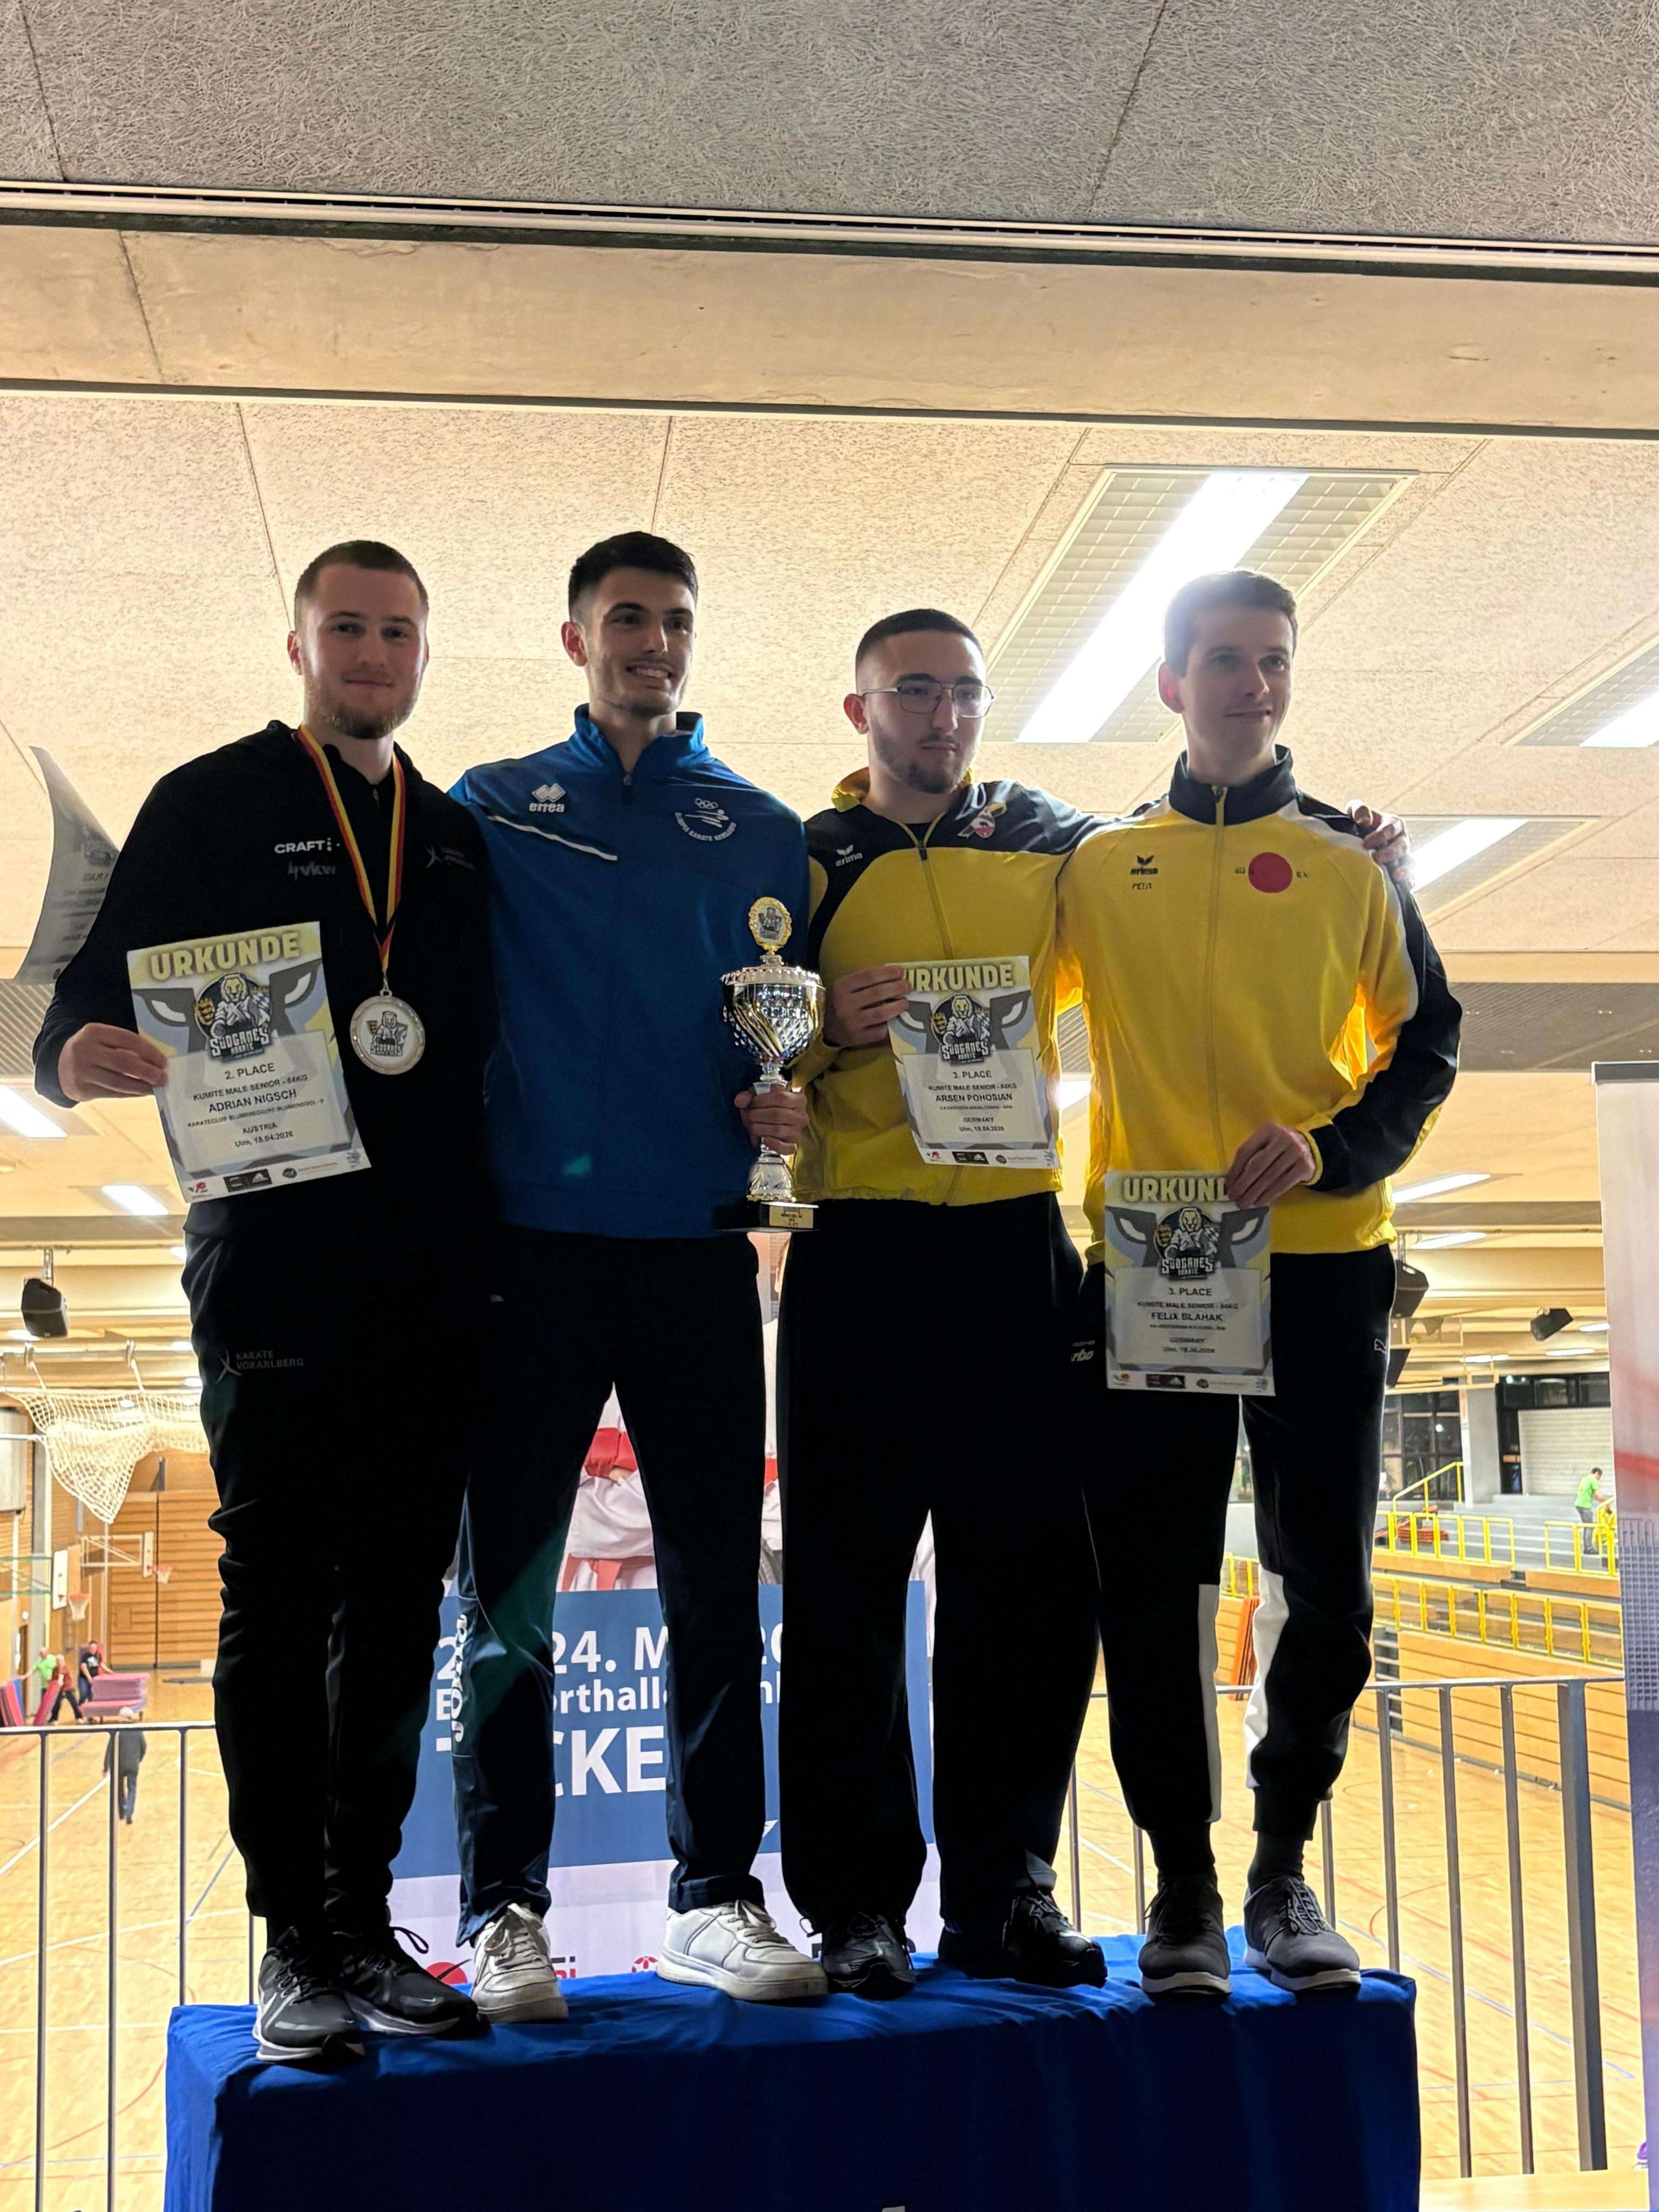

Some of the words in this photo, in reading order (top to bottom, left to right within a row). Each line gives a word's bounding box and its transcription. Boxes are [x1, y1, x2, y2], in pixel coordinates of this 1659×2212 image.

[274, 840, 326, 854] CRAFT
[835, 852, 864, 867] erima
[1130, 866, 1158, 875] erima
[151, 931, 300, 981] URKUNDE
[225, 1071, 234, 1080] 2.
[237, 1062, 275, 1077] PLACE
[962, 1070, 992, 1078] PLACE
[193, 1089, 225, 1101] KUMITE
[226, 1085, 249, 1095] MALE
[250, 1079, 280, 1091] SENIOR
[209, 1097, 252, 1112] ADRIAN
[254, 1089, 297, 1104] NIGSCH
[242, 1122, 278, 1135] AUSTRIA
[1179, 1287, 1212, 1296] PLACE
[1182, 1313, 1223, 1321] BLAHAK
[235, 1350, 274, 1360] KARATE
[237, 1358, 304, 1370] VORARLBERG
